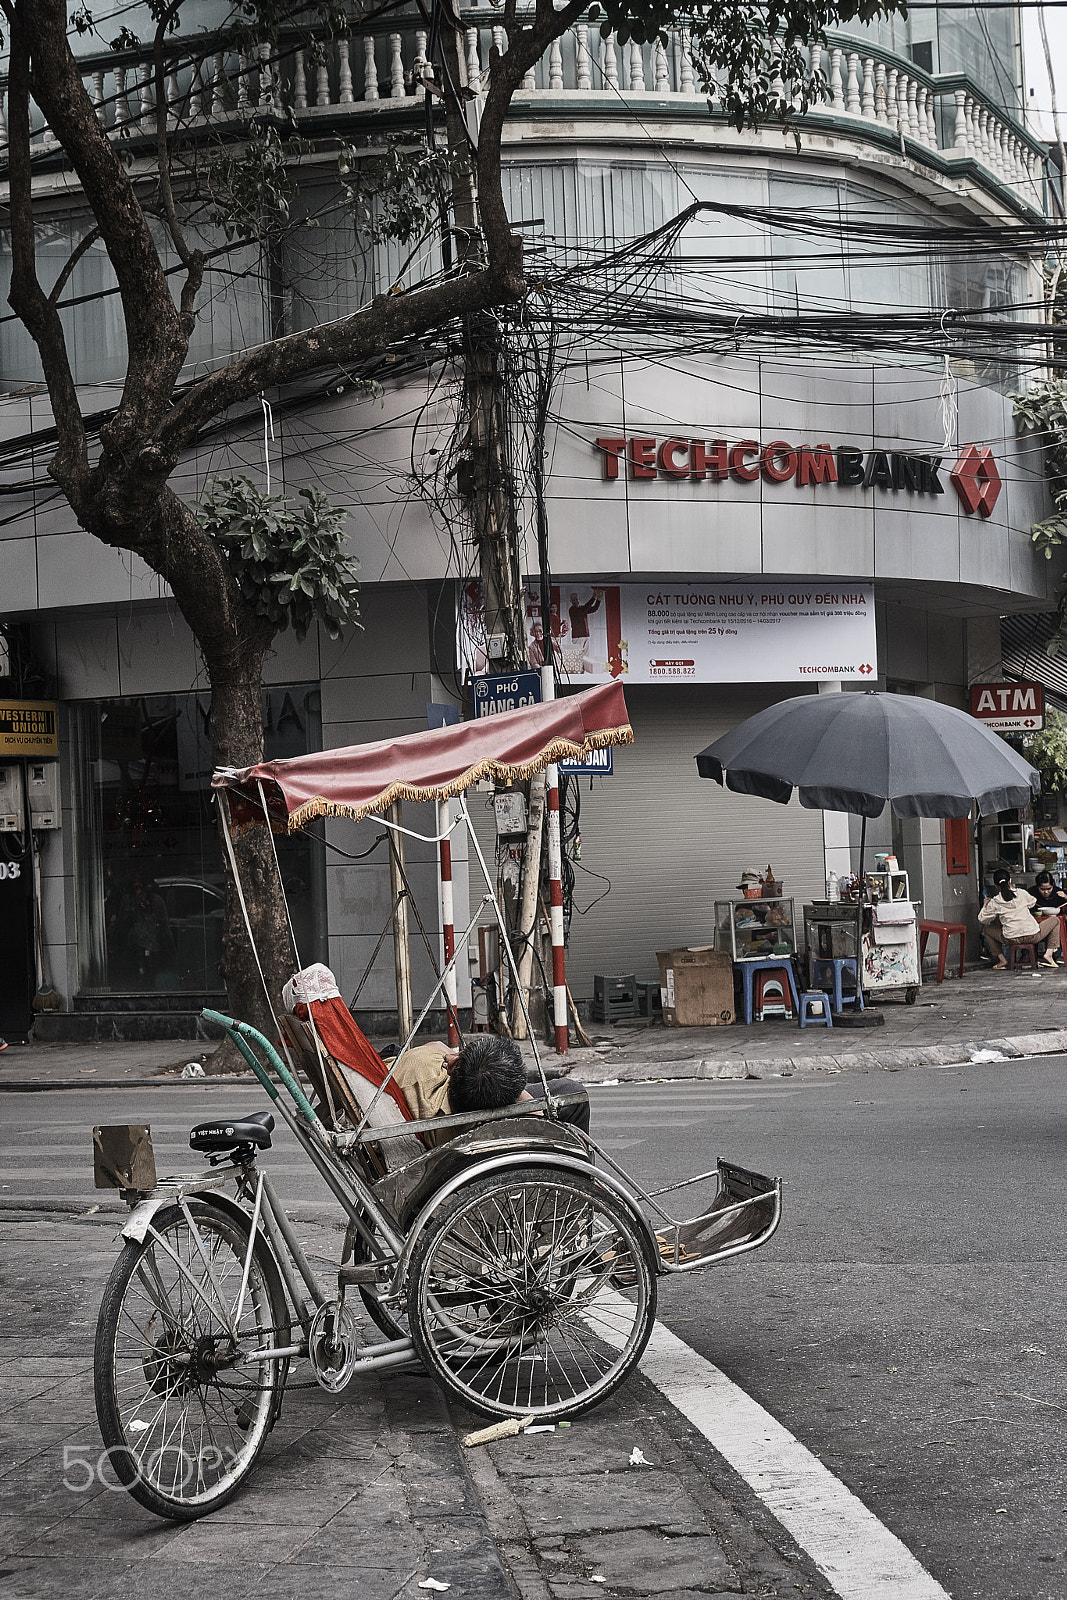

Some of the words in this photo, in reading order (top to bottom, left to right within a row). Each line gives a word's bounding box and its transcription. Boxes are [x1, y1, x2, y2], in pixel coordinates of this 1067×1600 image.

[596, 437, 945, 494] TECHCOMBANK
[647, 592, 671, 606] CÁT
[761, 592, 785, 605] PHÚ
[815, 591, 839, 605] ĐẾN
[842, 592, 867, 605] NHÀ
[708, 627, 717, 635] 25
[799, 666, 856, 674] TECHCOMBANK
[496, 678, 519, 694] PHỐ
[479, 696, 515, 717] HÀNG
[976, 688, 1037, 712] ATM
[12, 722, 45, 733] UNION
